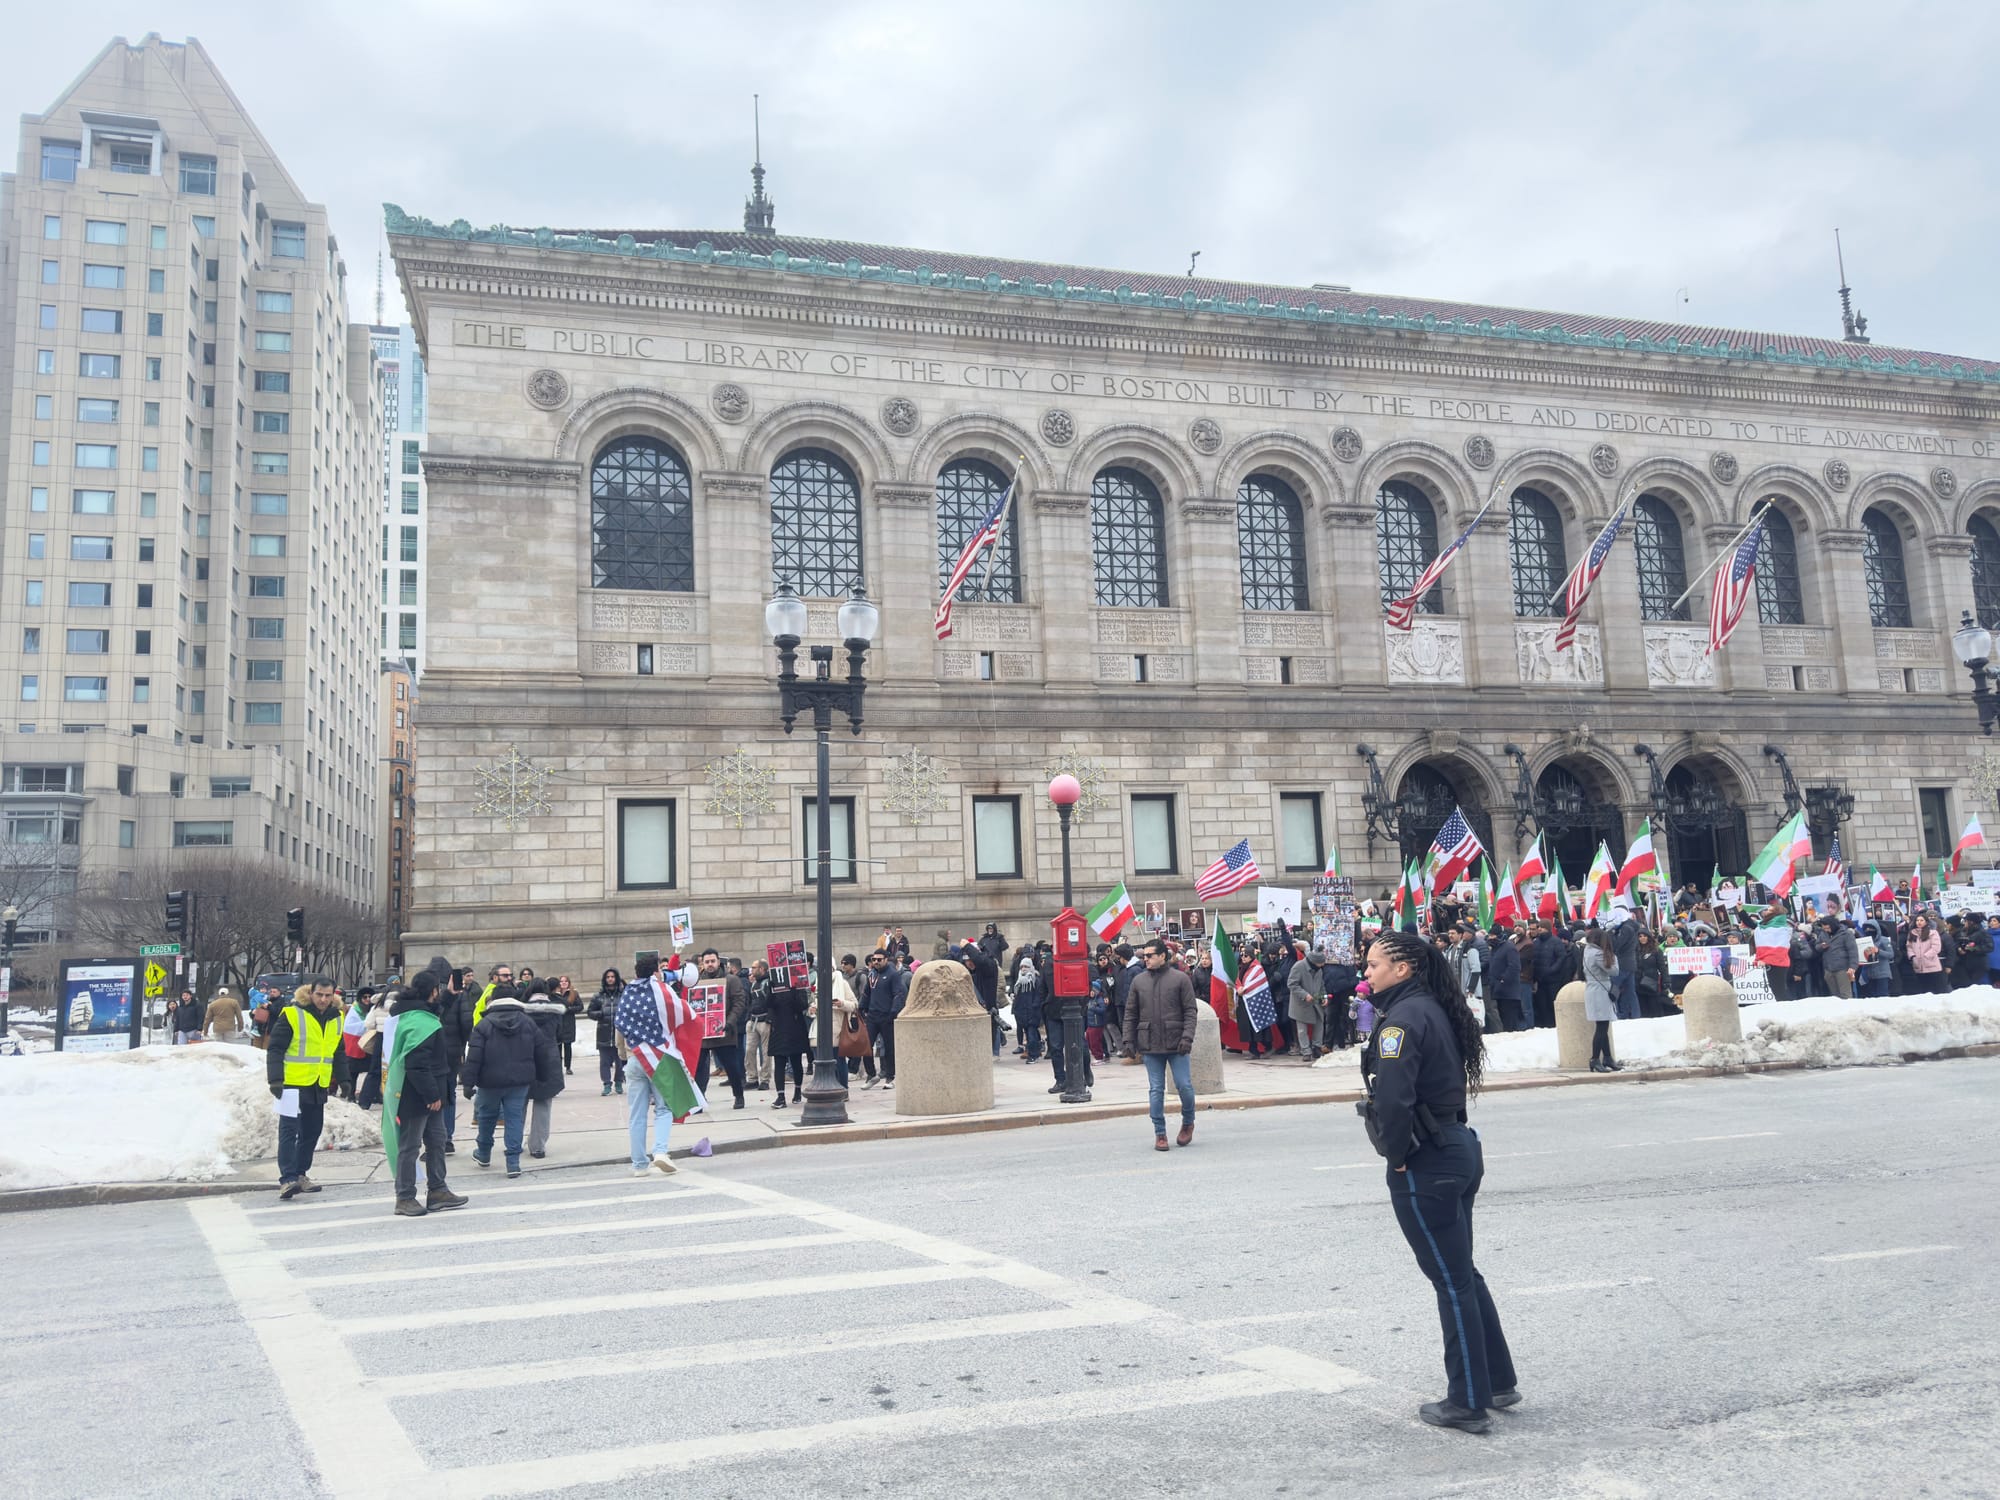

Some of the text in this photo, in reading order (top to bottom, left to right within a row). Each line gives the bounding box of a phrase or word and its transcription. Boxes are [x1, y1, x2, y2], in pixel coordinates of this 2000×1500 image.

[464, 323, 1997, 457] THE PUBLIC LIBRARY OF THE CITY OF BOSTON BUILT BY THE PEOPLE AND DEDICATED TO THE ADVANCEMENT OF
[144, 945, 172, 954] BLAGDEN
